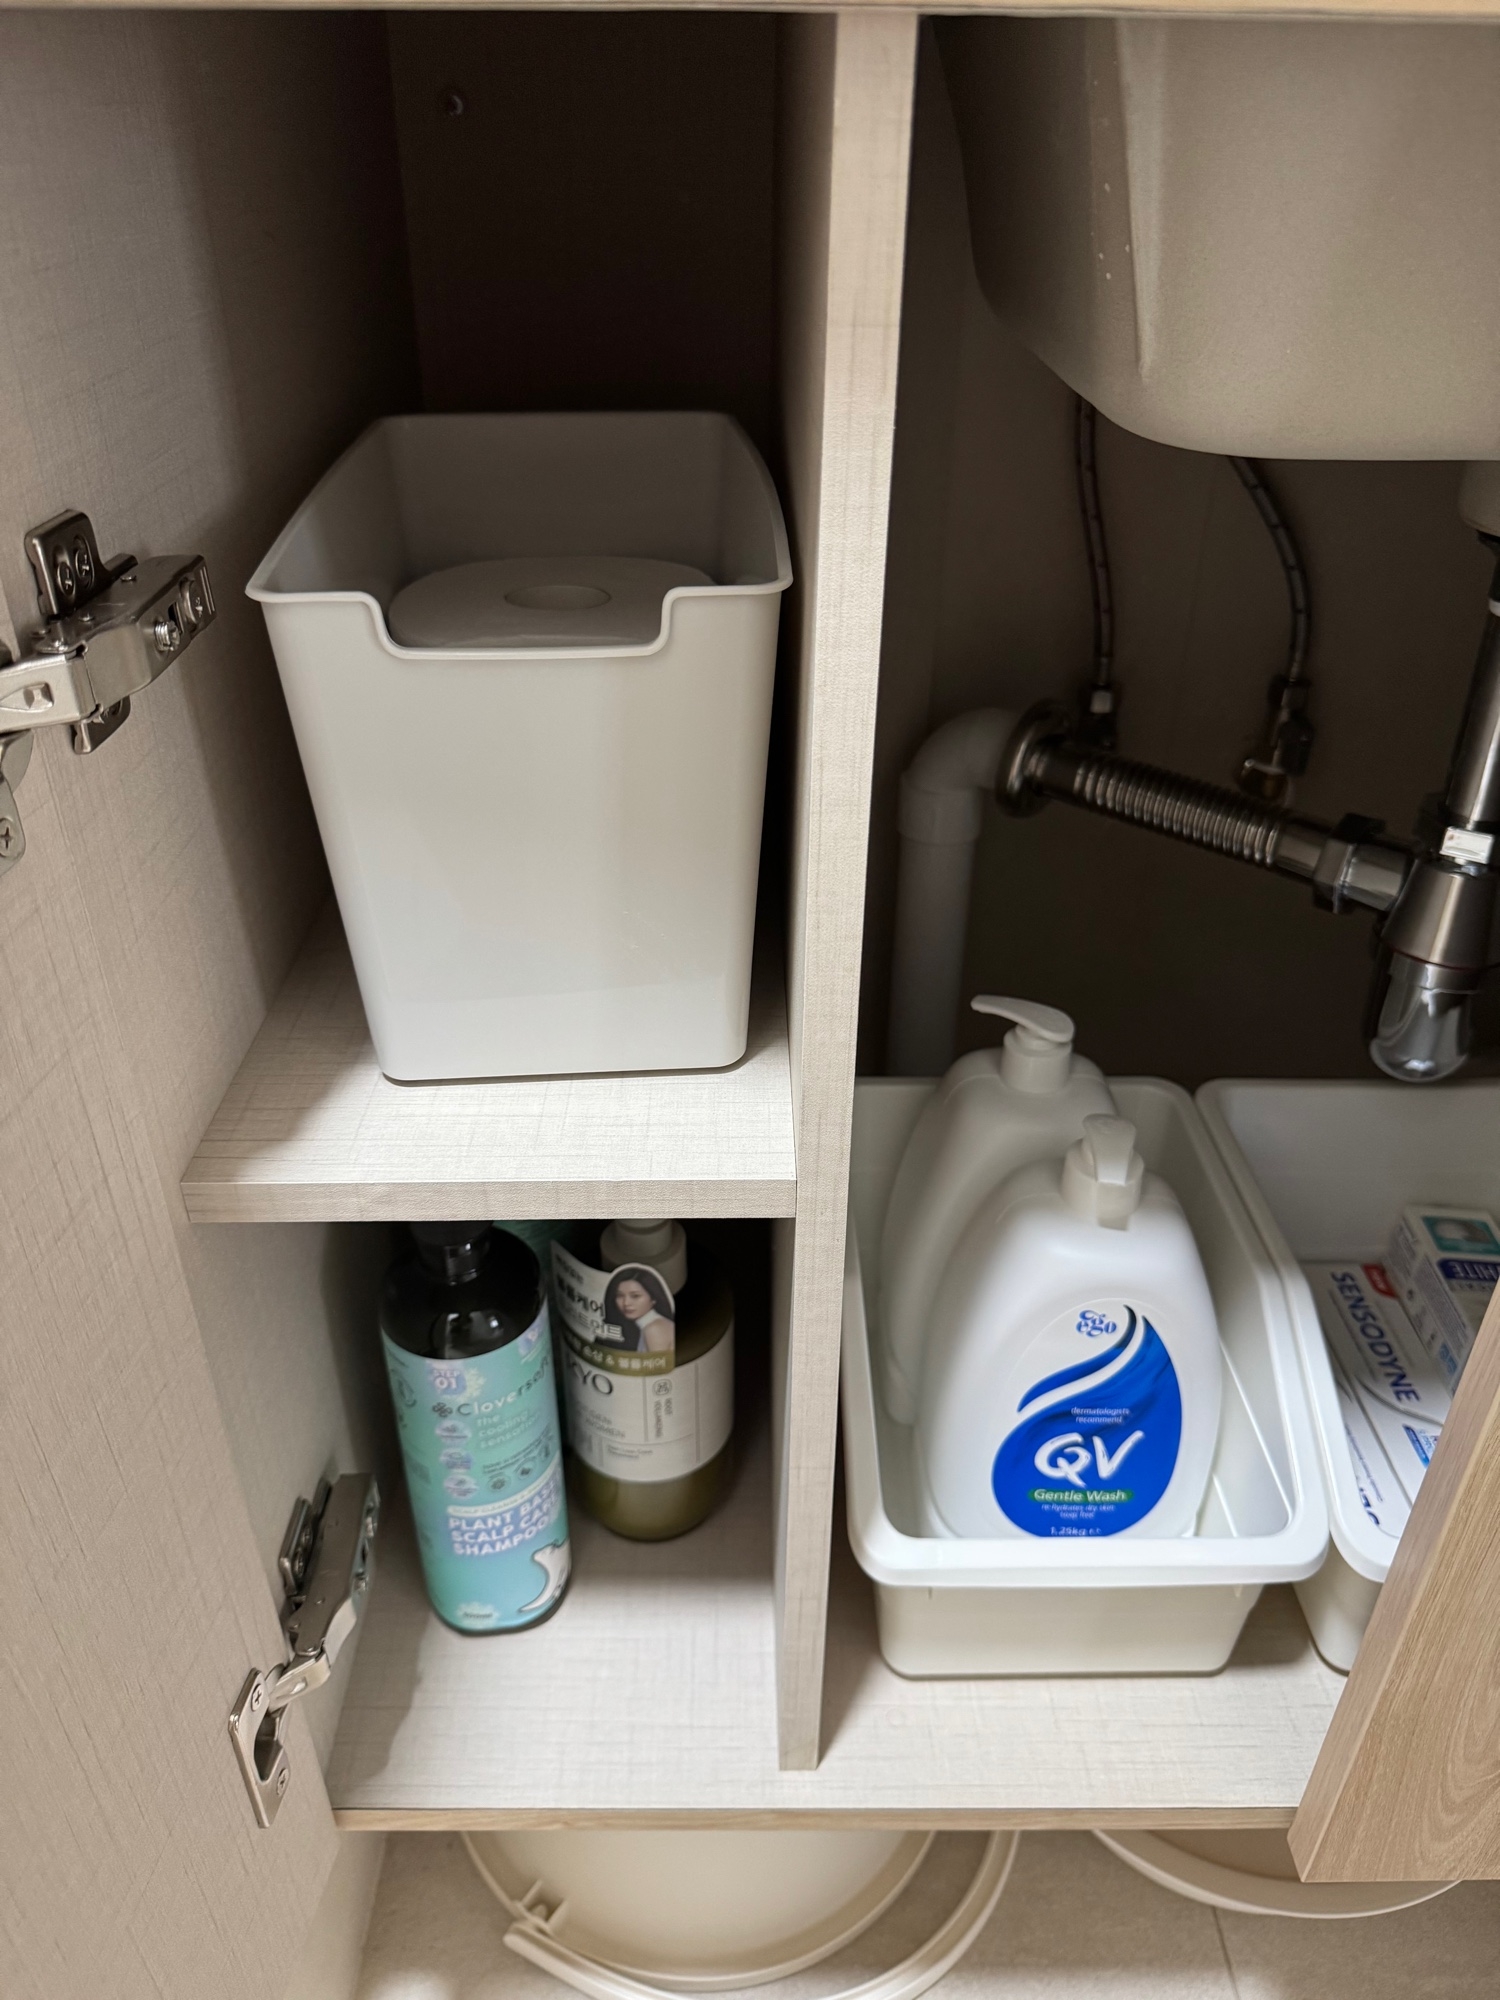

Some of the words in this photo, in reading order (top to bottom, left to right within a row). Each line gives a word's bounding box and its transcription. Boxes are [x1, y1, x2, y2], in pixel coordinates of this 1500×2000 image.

[1330, 1271, 1420, 1403] SENSODYNE
[434, 1377, 457, 1389] 01
[1034, 1430, 1145, 1488] QV
[1034, 1489, 1083, 1502] Gentle
[1086, 1489, 1127, 1502] Wash
[450, 1510, 514, 1530] PLANT
[452, 1524, 514, 1543] SCALP
[454, 1515, 549, 1555] SHAMPOO
